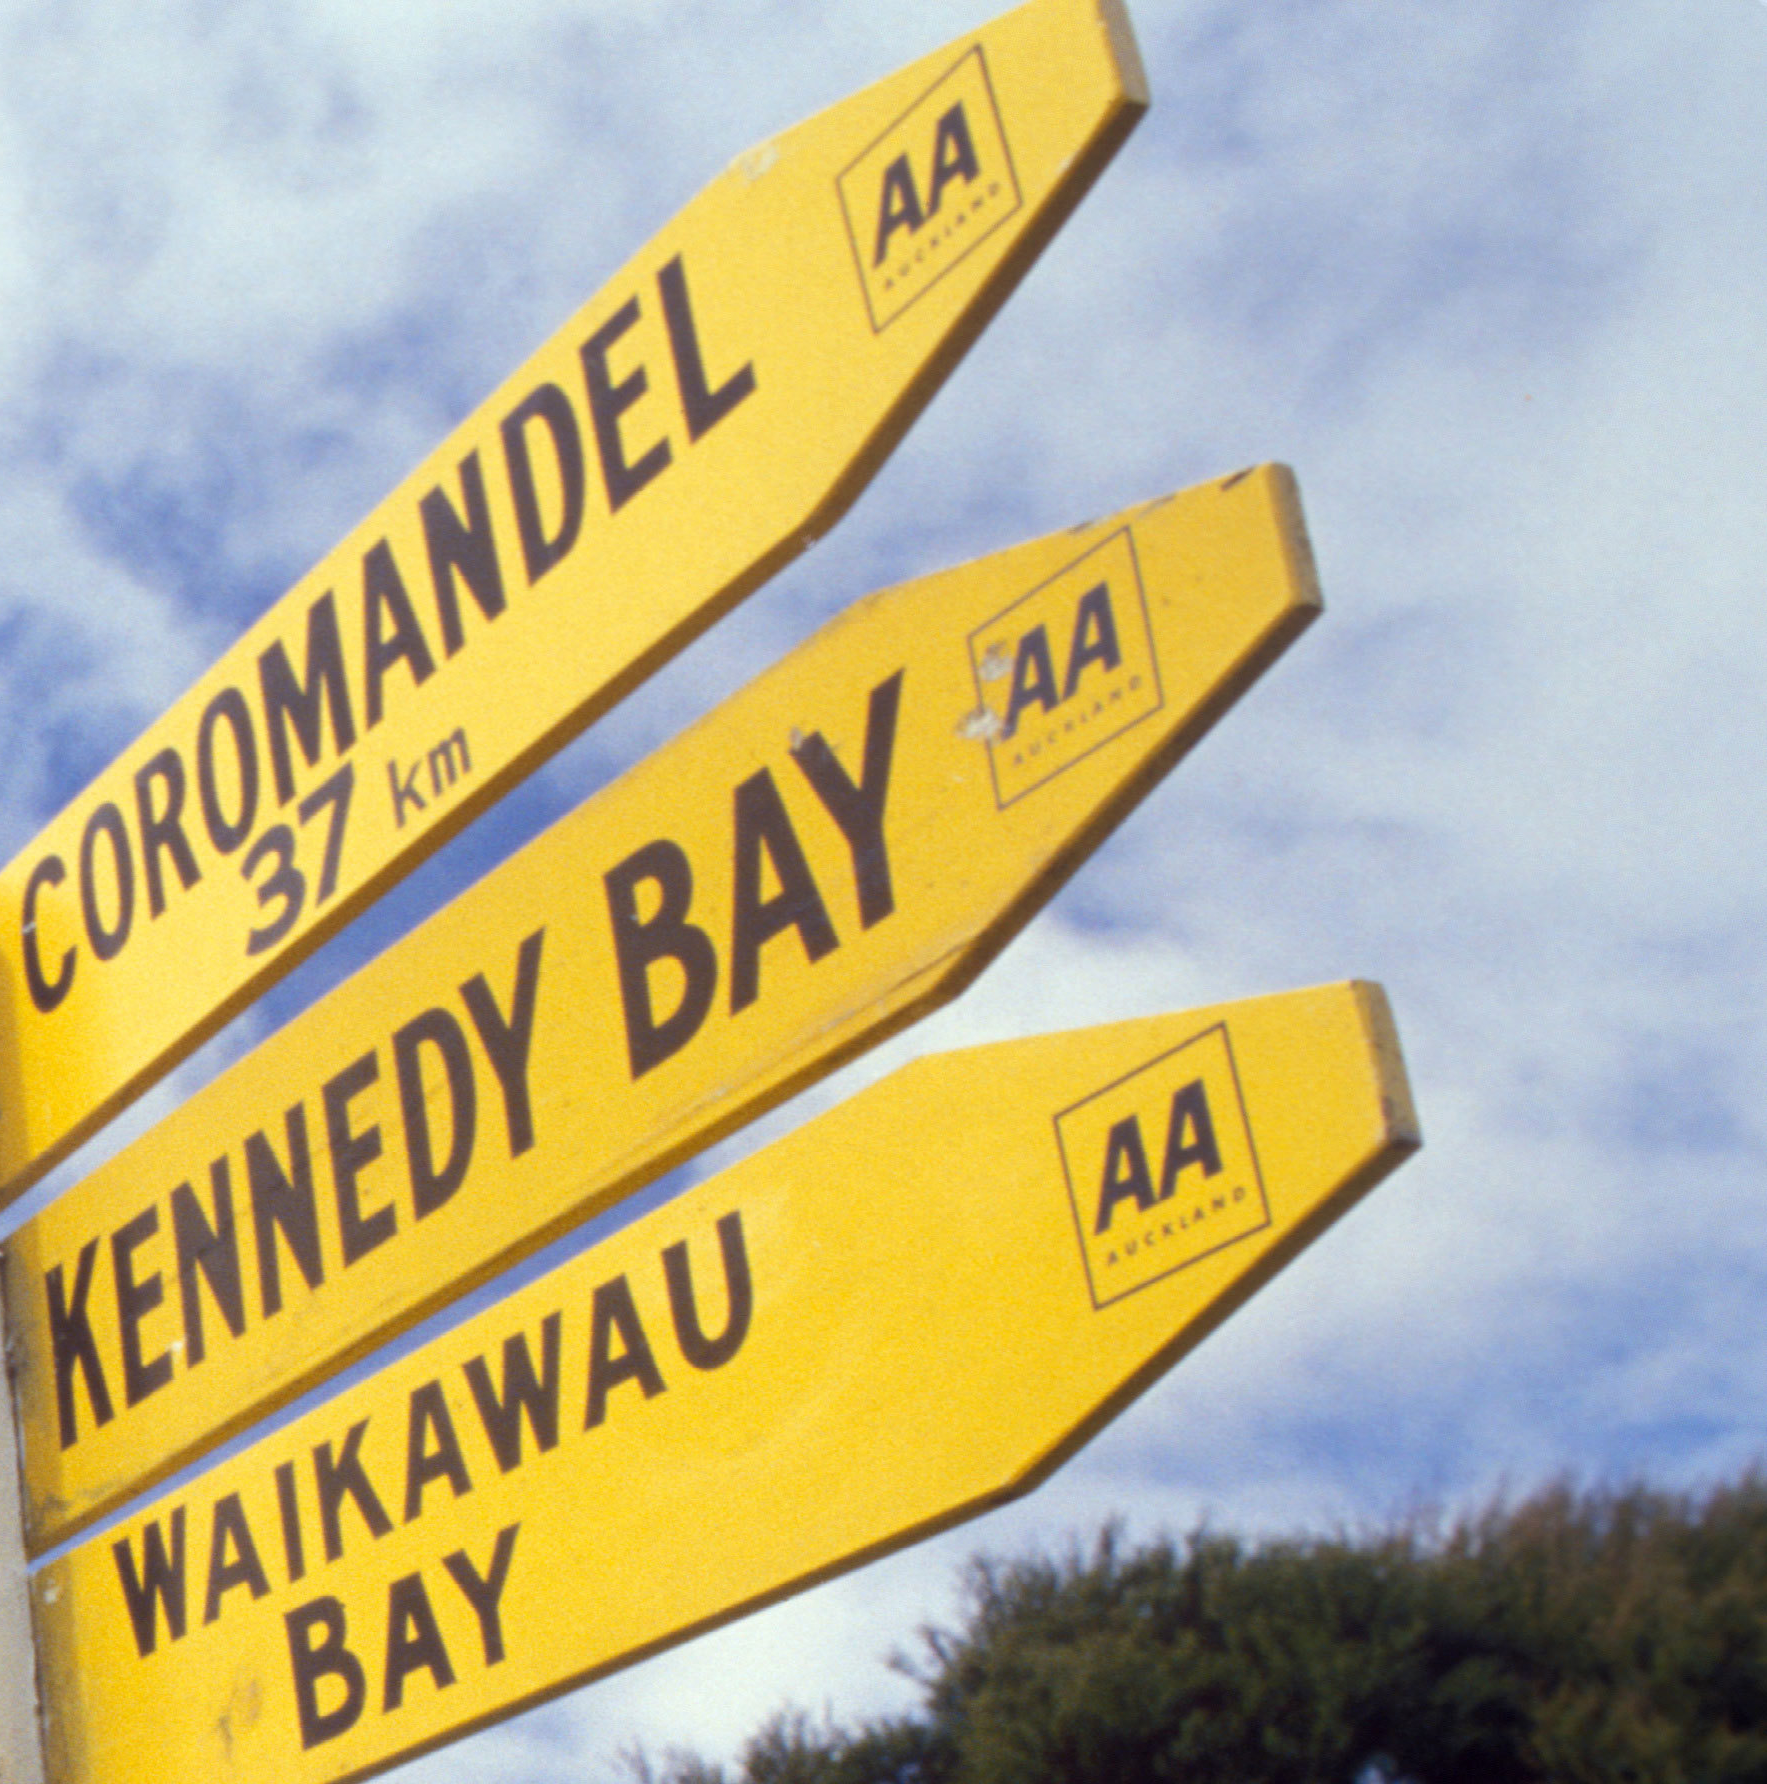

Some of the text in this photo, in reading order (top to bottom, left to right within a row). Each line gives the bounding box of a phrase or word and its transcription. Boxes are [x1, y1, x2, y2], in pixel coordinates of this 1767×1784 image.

[873, 100, 980, 269] AA
[884, 180, 1001, 292] AUCKLAND
[22, 253, 757, 1014] COROMANDEL
[1002, 581, 1121, 741] AA
[1013, 675, 1142, 768] AUCKLAND
[240, 727, 473, 957] 37 km
[44, 667, 905, 1452] KENNEDY BAY
[1093, 1078, 1223, 1236] AA
[1106, 1186, 1246, 1267] AUCKLAND
[112, 1209, 753, 1659] WAIKAWAU
[285, 1522, 521, 1751] BAY
